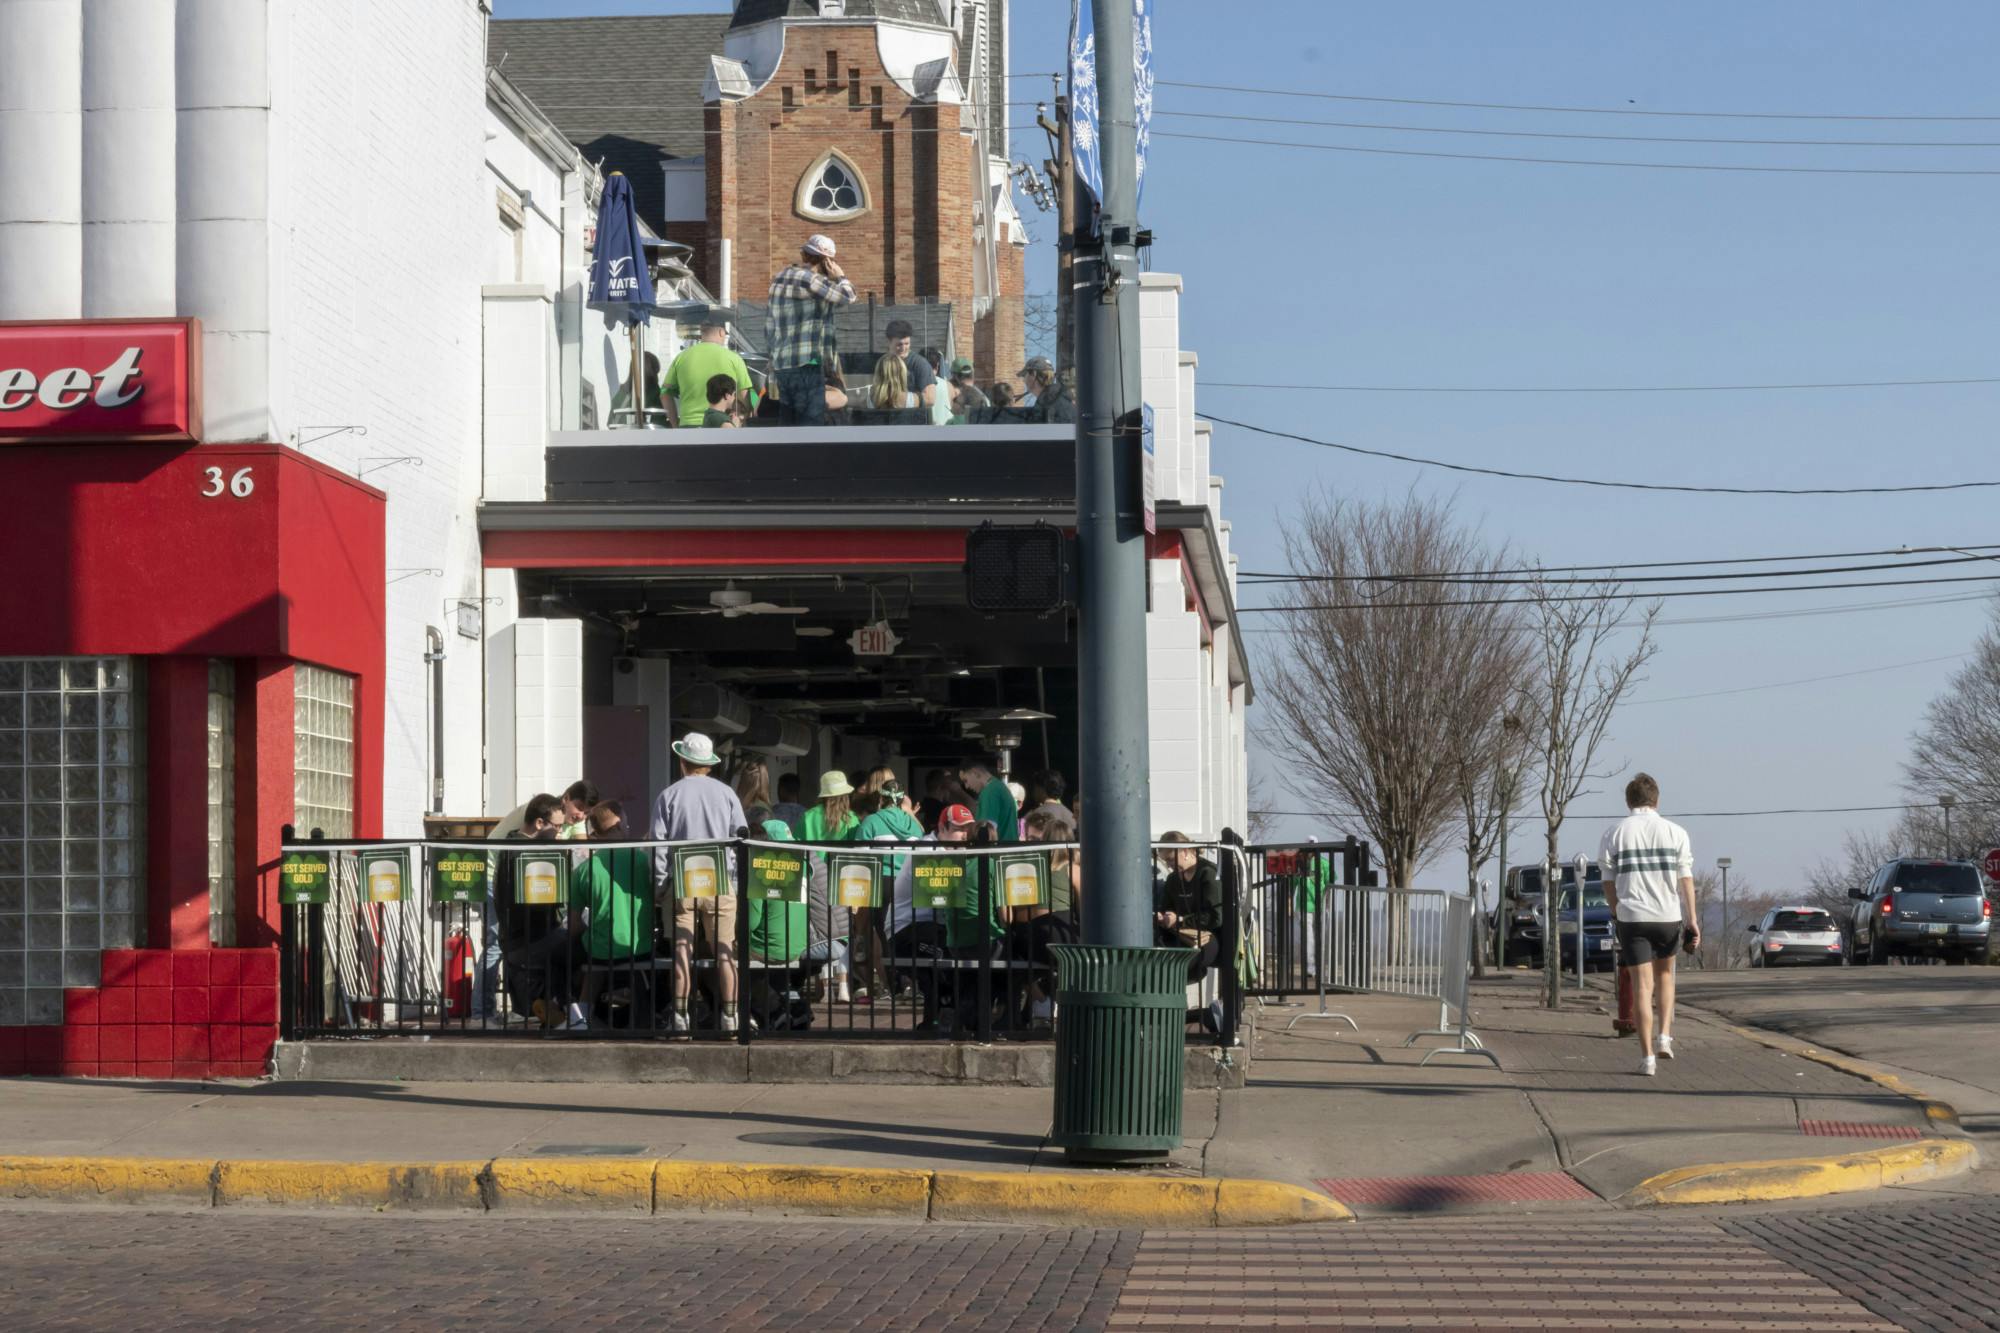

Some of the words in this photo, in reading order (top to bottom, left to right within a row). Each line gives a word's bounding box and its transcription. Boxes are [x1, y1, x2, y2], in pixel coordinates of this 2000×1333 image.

[0, 347, 144, 410] eet
[201, 466, 255, 498] 36
[860, 631, 887, 652] EXIT
[300, 863, 327, 873] SERVED
[437, 861, 456, 871] BEST
[457, 861, 485, 871] SERVED
[752, 858, 772, 869] BEST
[772, 859, 801, 871] SERVED
[1986, 859, 2000, 872] ST
[451, 872, 471, 882] GOLD
[765, 870, 786, 881] GOLD
[915, 867, 934, 877] BEST
[935, 867, 963, 877] SERVED
[293, 874, 314, 884] GOLD
[929, 878, 949, 887] GOLD
